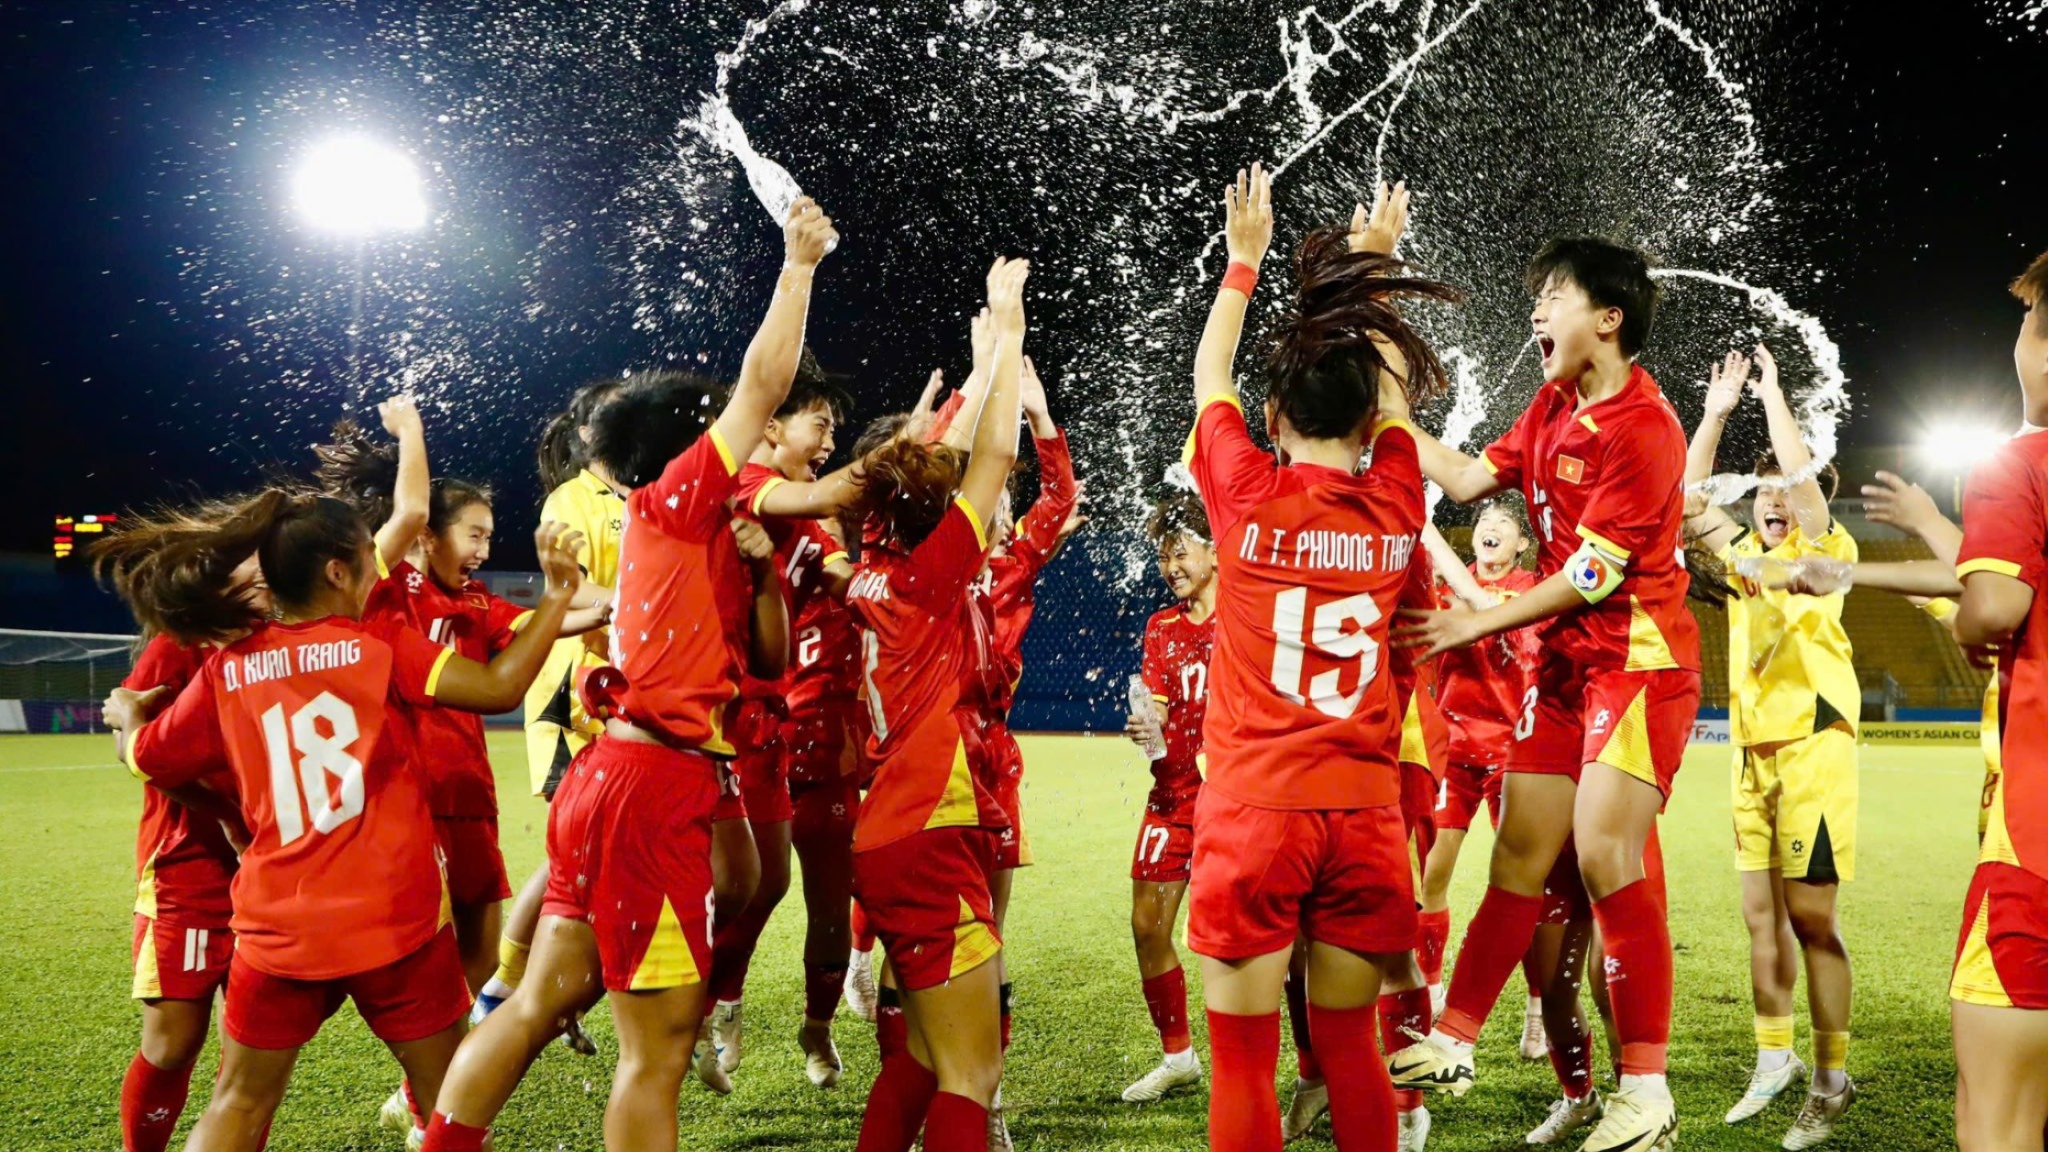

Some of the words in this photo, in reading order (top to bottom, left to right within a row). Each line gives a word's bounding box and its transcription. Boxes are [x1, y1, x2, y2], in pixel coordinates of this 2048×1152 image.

[1271, 528, 1287, 566] T.
[1294, 530, 1374, 573] PHUONG
[296, 639, 361, 674] TRANG
[1862, 729, 1921, 739] WOMEN'S
[1923, 729, 1960, 739] ASIAN
[260, 690, 365, 848] 18
[1138, 824, 1169, 864] 17
[183, 927, 209, 972] 11
[1408, 1063, 1474, 1084] AIR
